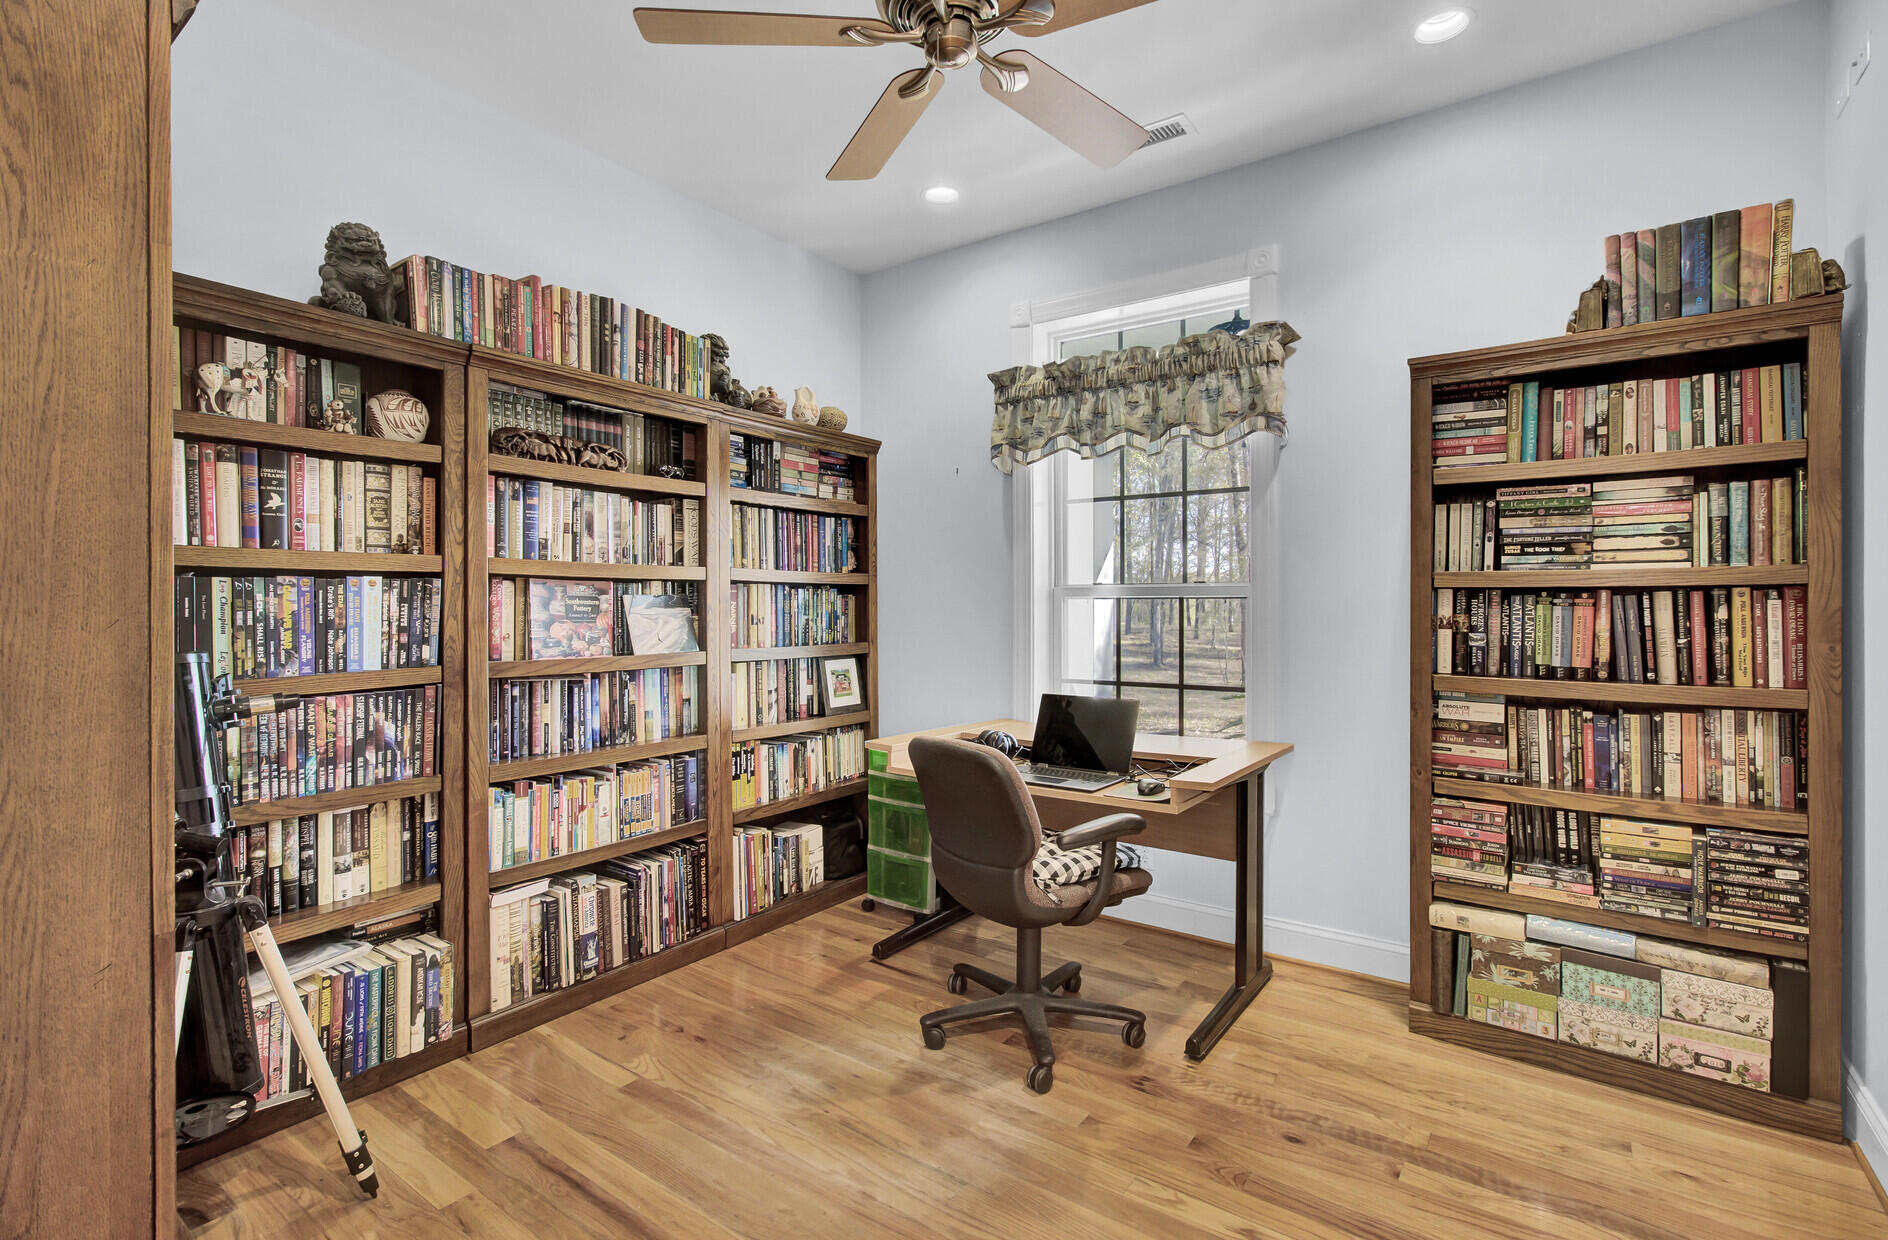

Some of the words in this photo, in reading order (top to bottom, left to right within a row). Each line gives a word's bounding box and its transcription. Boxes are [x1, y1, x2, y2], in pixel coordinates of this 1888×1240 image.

[1781, 216, 1790, 237] HARRY
[1780, 241, 1789, 267] POTTER
[218, 596, 228, 635] Champion
[1512, 604, 1522, 646] ATLANTIS
[1525, 604, 1535, 646] ATLANTIS
[284, 630, 292, 649] WAR
[308, 725, 315, 735] OF
[1738, 753, 1746, 783] LIBERTY
[1569, 812, 1578, 829] BLOOD
[1591, 816, 1600, 834] BATTLE
[301, 822, 309, 846] GOSPEL
[427, 831, 437, 844] 8th
[1558, 829, 1566, 848] WORLD
[1569, 831, 1578, 850] WORLD
[1442, 847, 1473, 859] ASSASSIN
[240, 988, 251, 1038] CELESTRON
[321, 987, 331, 1027] WATCHMEN
[345, 1011, 353, 1042] DUNE
